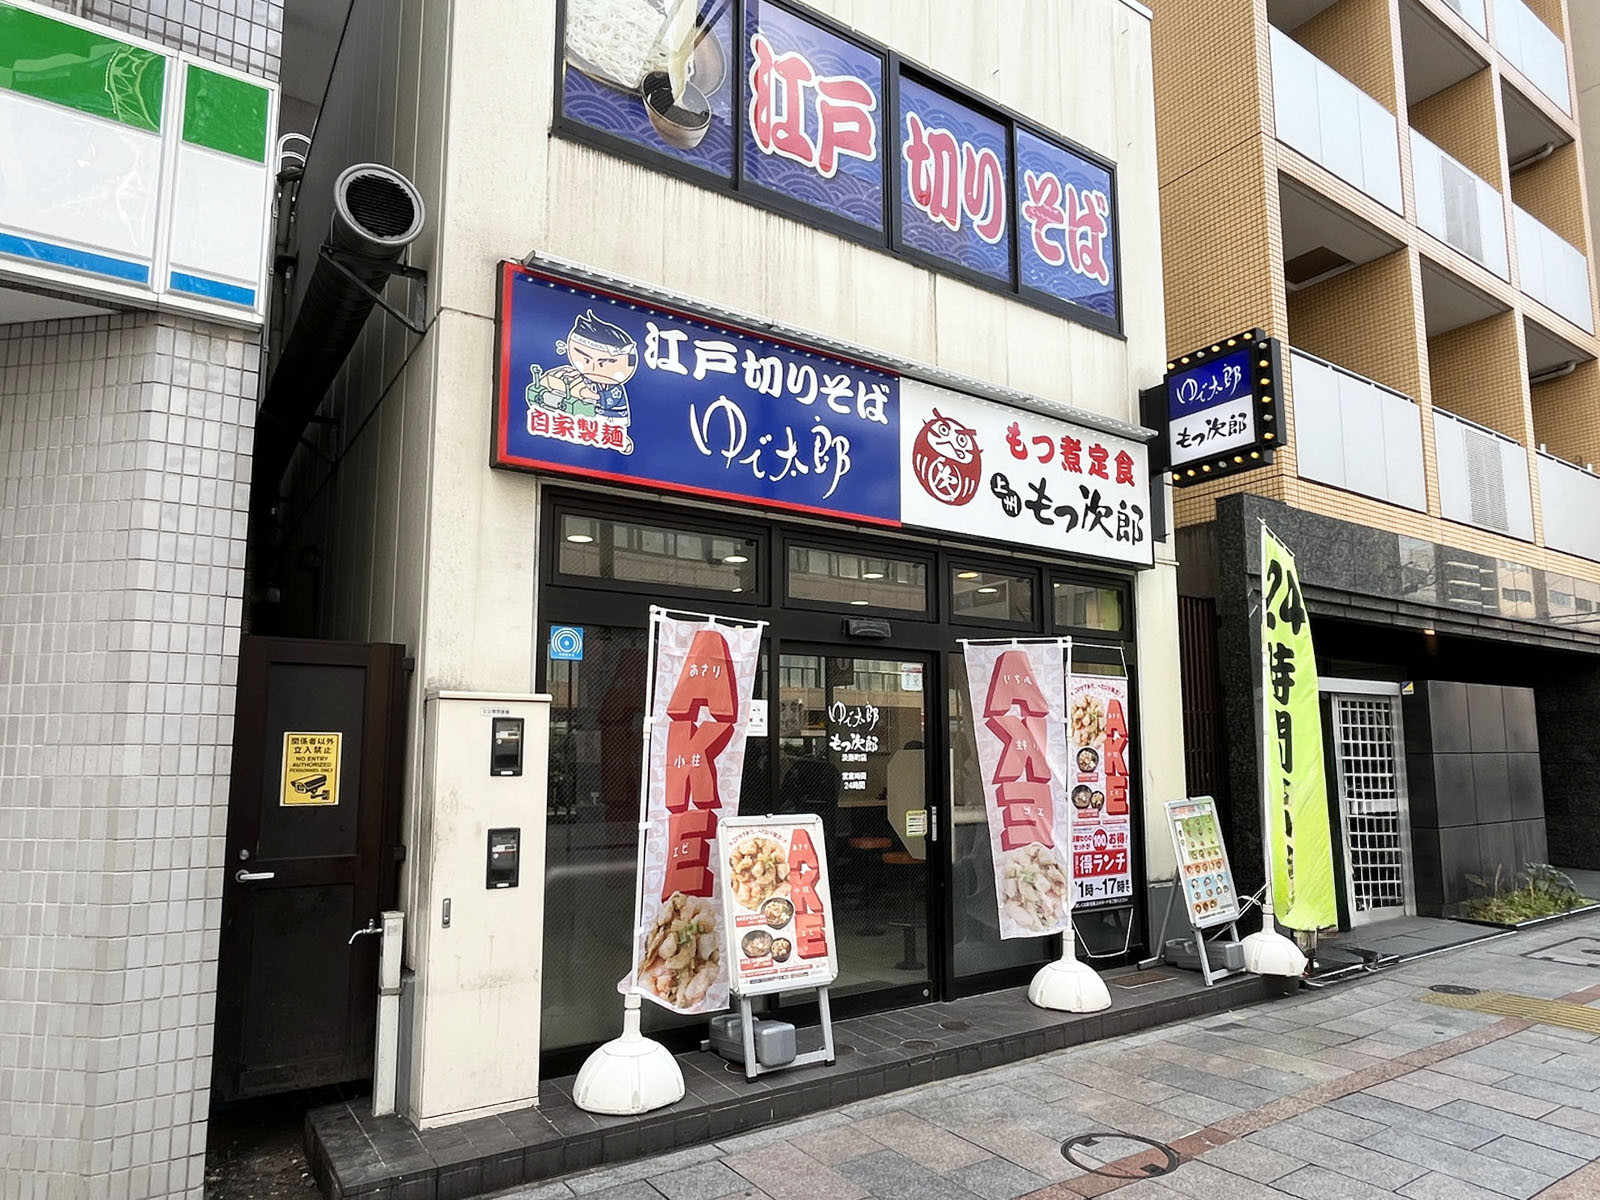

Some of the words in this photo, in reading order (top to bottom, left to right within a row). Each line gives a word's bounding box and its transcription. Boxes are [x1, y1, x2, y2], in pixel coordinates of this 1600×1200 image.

[751, 33, 1110, 286] 江戸切りそば
[644, 321, 891, 425] 江戸切りそば
[1176, 363, 1242, 404] ゆで太郎
[530, 408, 624, 447] 自家製麺
[689, 395, 852, 500] ゆで太郎
[1175, 413, 1247, 449] もつ次郎
[1005, 420, 1136, 487] もつ煮定食
[1024, 477, 1144, 546] もつ次郎
[688, 662, 721, 679] あさり
[828, 701, 880, 731] ゆで太郎
[291, 737, 334, 745] 関係者以外
[293, 746, 331, 754] 立入禁止
[674, 753, 701, 768] 小柱
[828, 733, 879, 752] もつ次郎
[1104, 699, 1129, 815] AKE
[661, 630, 737, 902] AKE
[672, 842, 689, 858] エビ
[787, 829, 828, 960] AKE
